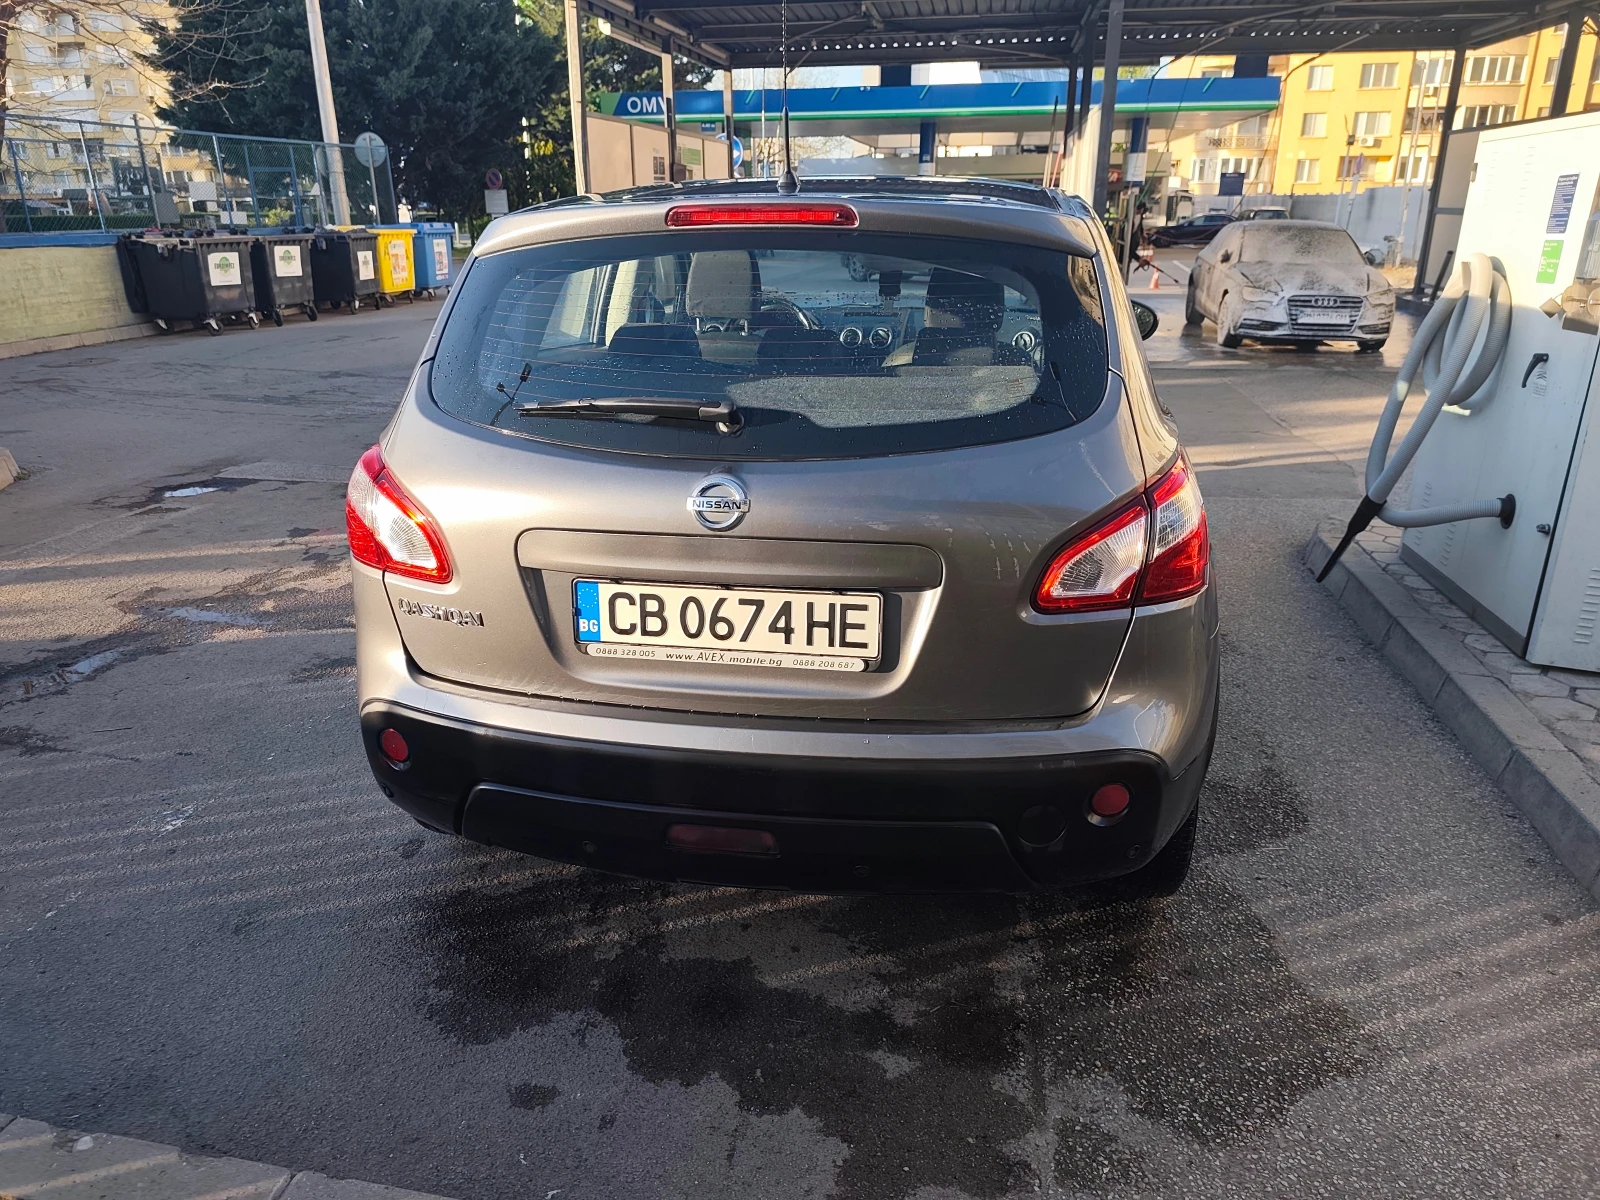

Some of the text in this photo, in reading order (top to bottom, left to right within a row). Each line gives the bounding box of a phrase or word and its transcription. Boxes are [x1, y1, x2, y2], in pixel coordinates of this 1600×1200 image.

[692, 499, 742, 510] NISSAN
[398, 597, 485, 627] QASHQAI
[579, 618, 599, 632] BG
[608, 591, 869, 649] CB 0674 HE
[595, 647, 617, 655] 0888
[639, 650, 656, 658] 005
[792, 658, 855, 669] 0888 208 687
